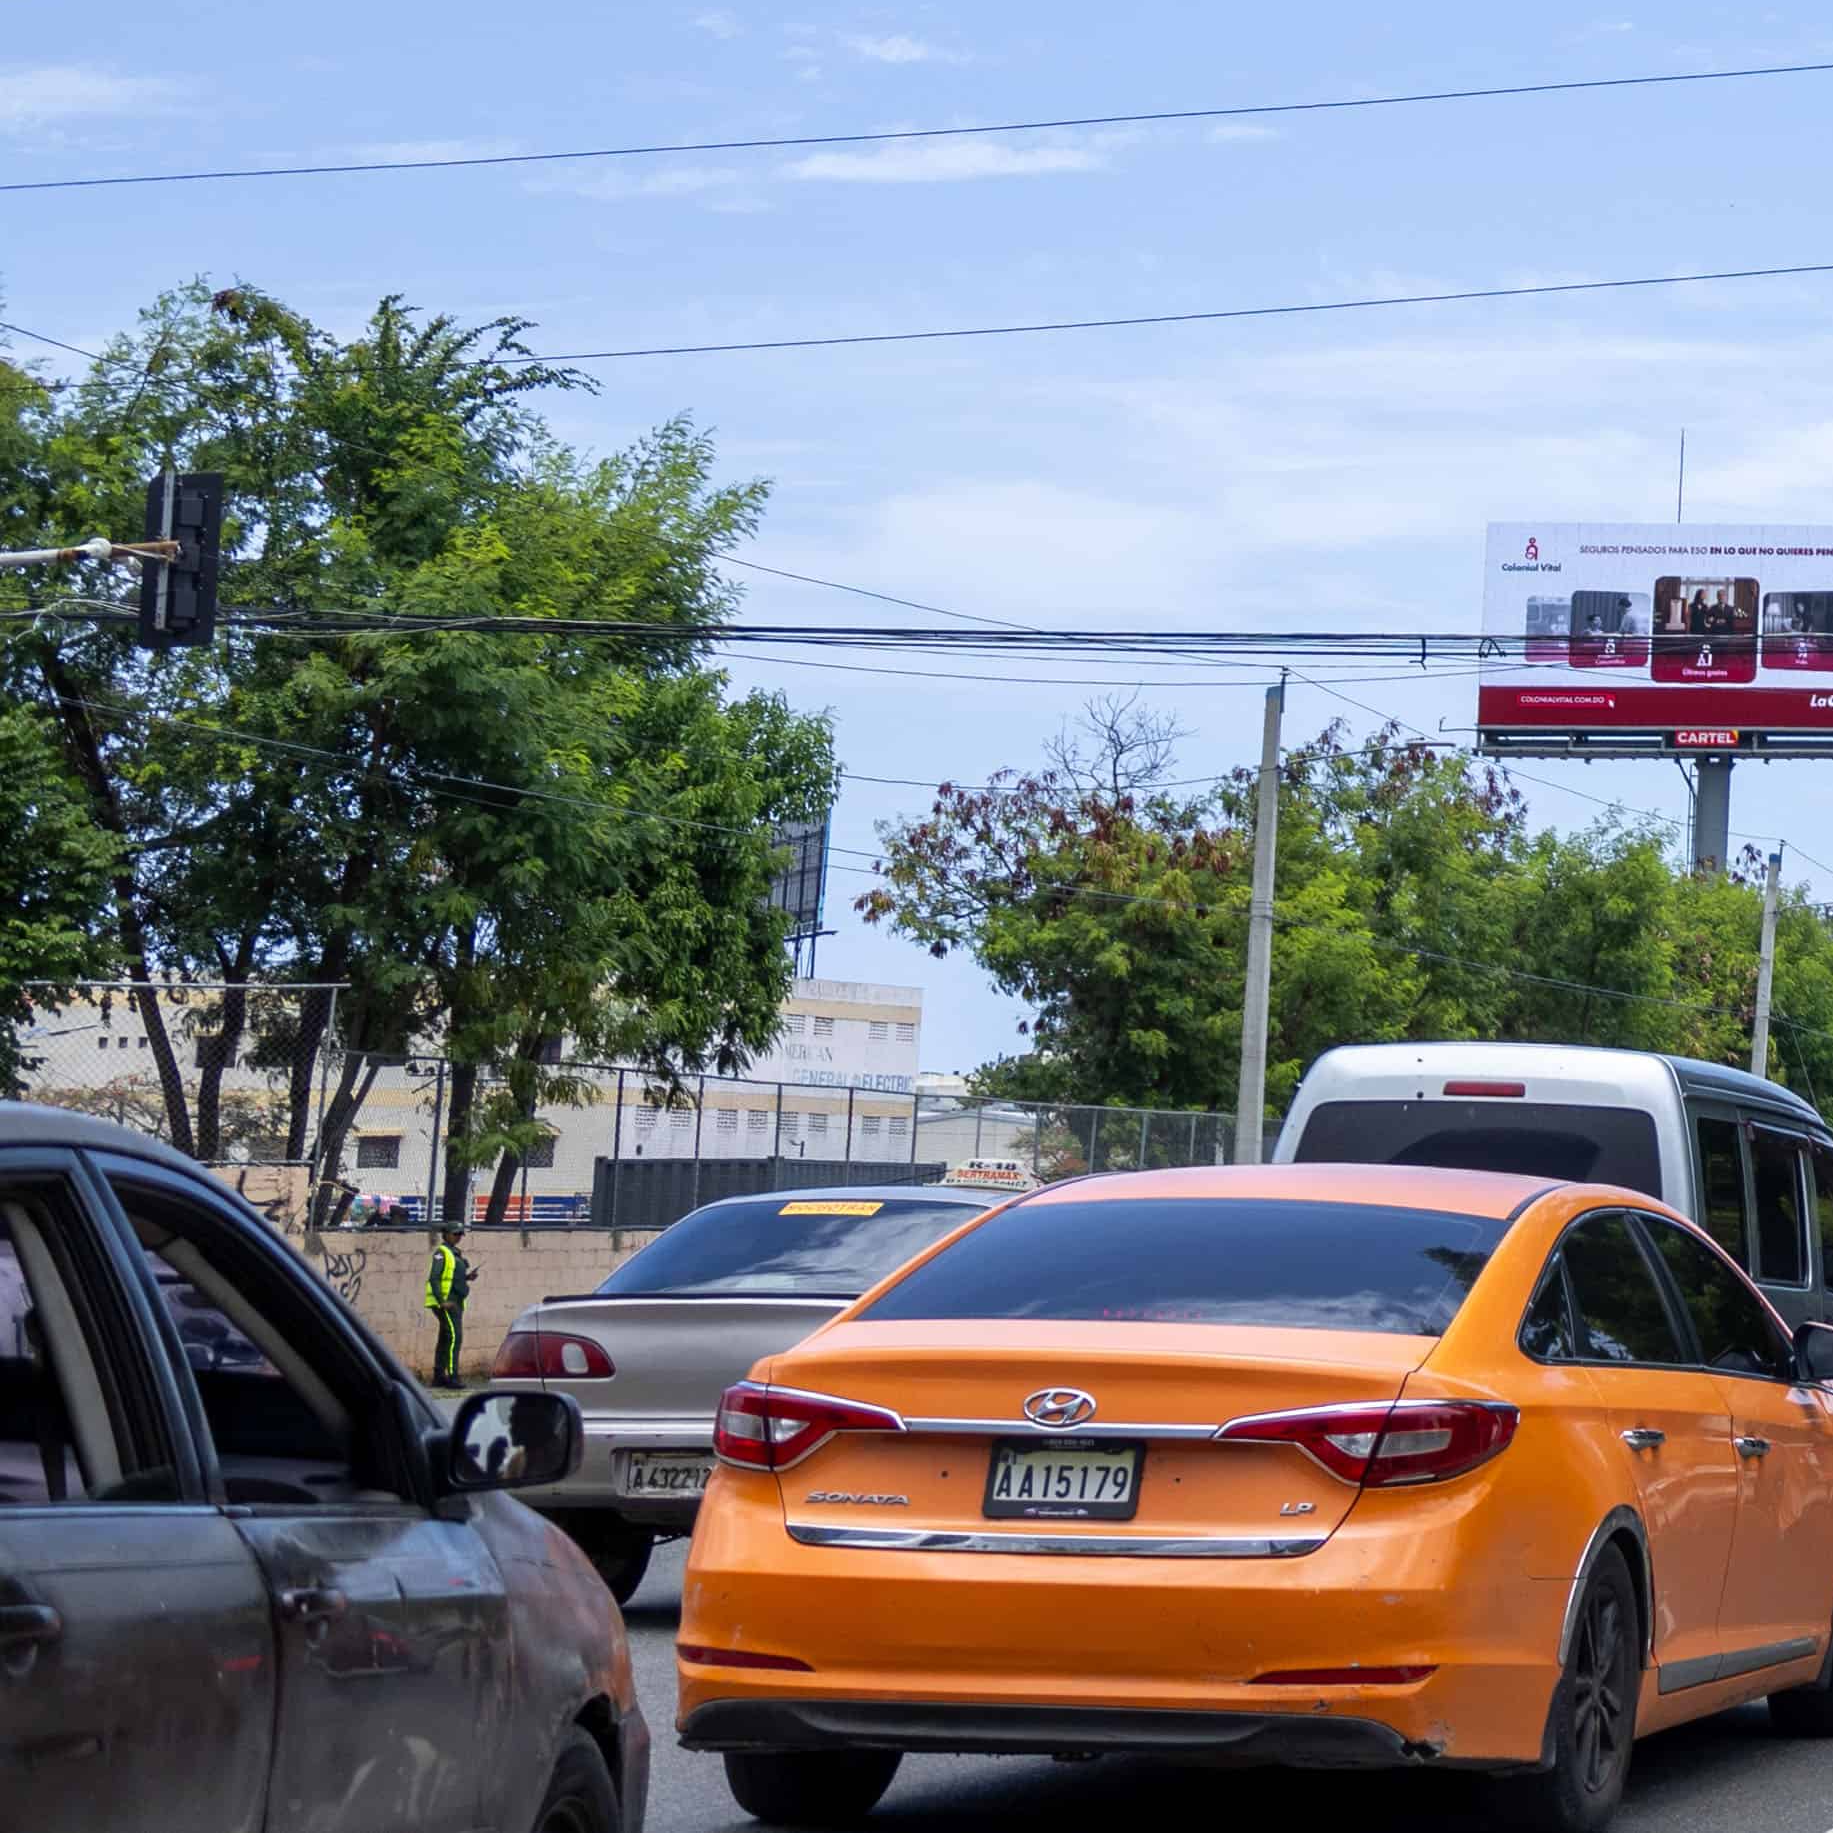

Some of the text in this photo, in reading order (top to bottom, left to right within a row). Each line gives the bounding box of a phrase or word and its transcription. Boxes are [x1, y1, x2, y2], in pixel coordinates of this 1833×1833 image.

[1709, 546, 1722, 555] EN
[1723, 546, 1736, 555] LO
[1738, 546, 1757, 556] QUE
[1759, 546, 1774, 556] NO
[1776, 547, 1814, 556] QUIERES
[1501, 562, 1562, 572] Colonial Vital
[1676, 731, 1735, 745] CARTEL
[862, 1072, 914, 1091] ELECTRIC
[995, 1464, 1130, 1500] AA15179
[805, 1490, 911, 1505] SONATA
